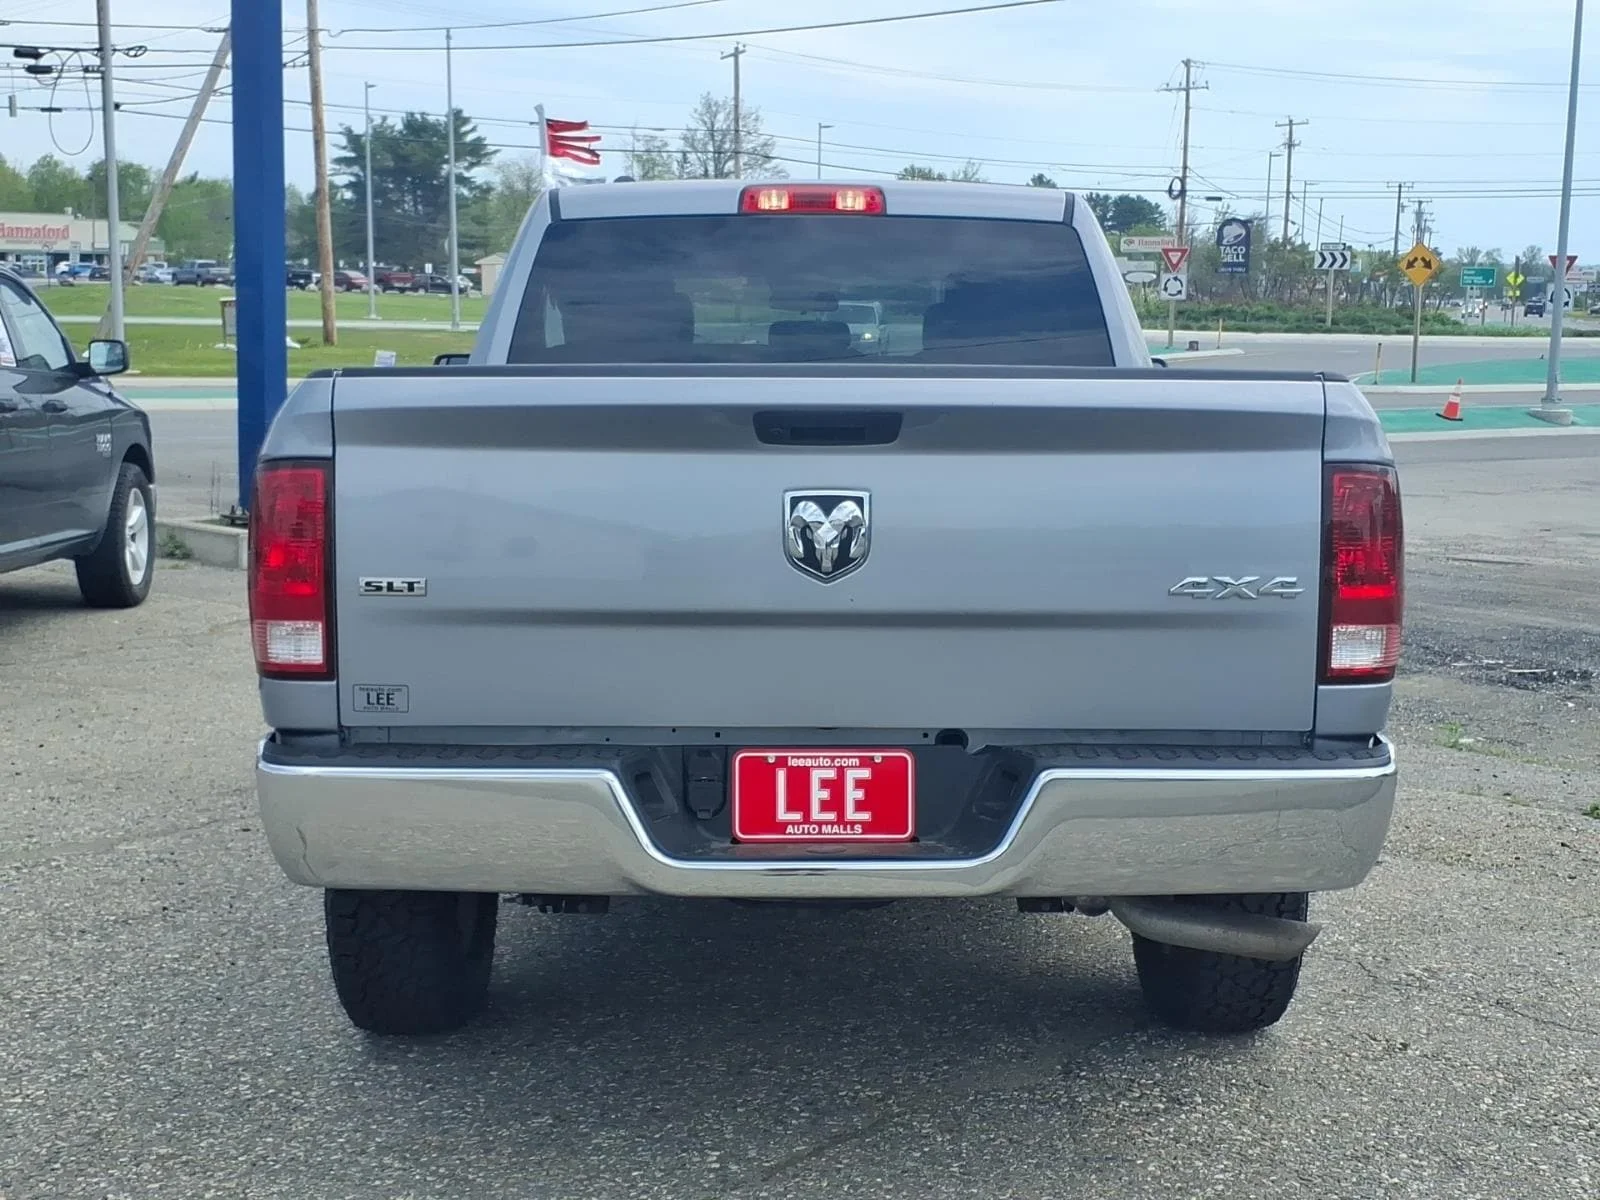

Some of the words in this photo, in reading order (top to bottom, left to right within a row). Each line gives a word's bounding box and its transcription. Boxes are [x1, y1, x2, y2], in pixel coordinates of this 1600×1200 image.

[1220, 245, 1246, 254] TACO
[364, 580, 421, 593] SLT
[366, 693, 396, 706] LEE
[787, 756, 860, 767] leeauto.com
[776, 768, 871, 822] LEE
[785, 825, 819, 834] AUTO
[821, 824, 863, 834] MALLS
